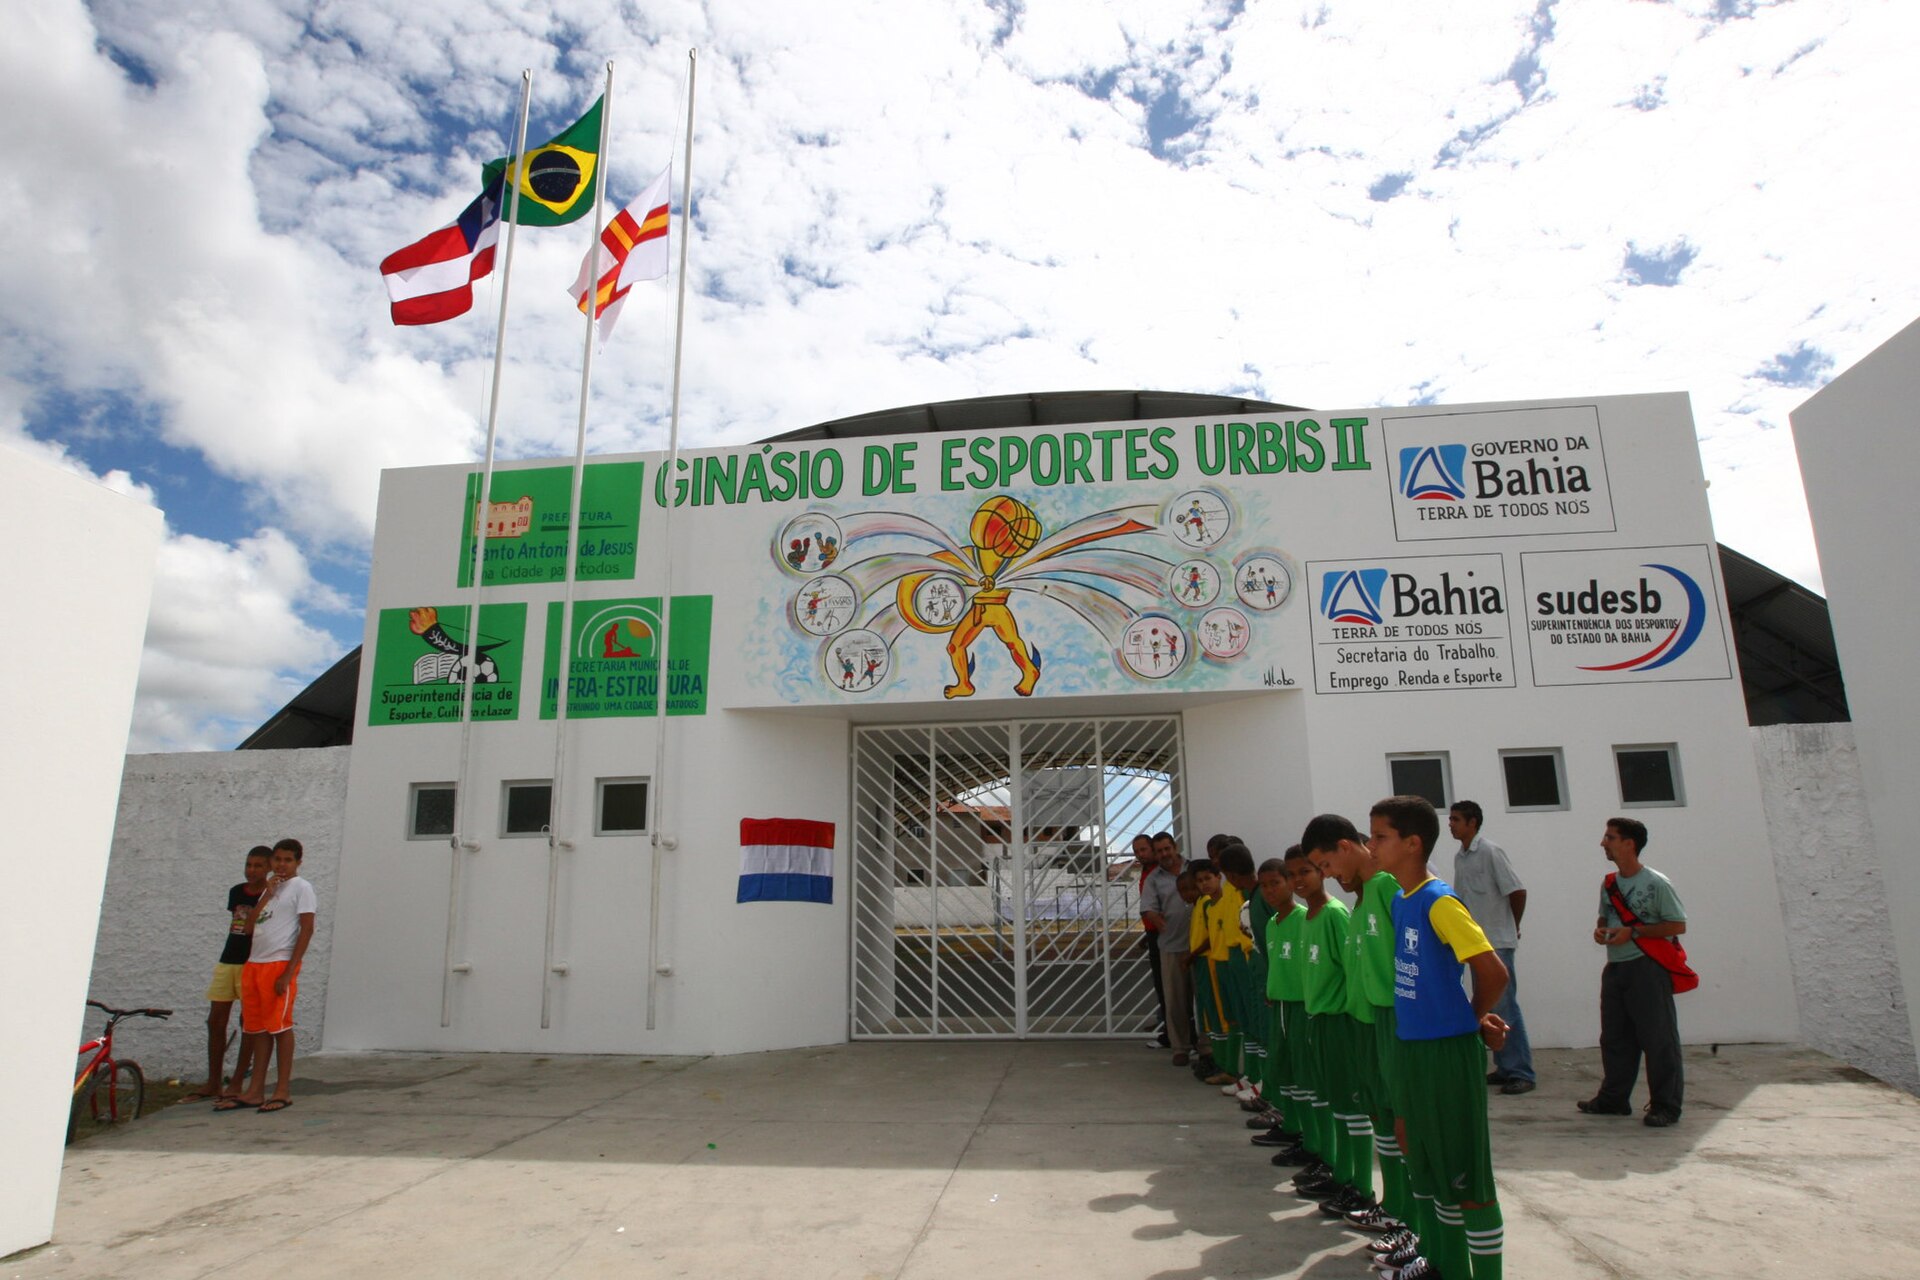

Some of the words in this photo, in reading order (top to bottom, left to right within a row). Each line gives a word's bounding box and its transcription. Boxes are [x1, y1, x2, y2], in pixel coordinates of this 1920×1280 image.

[1471, 438, 1558, 457] GOVERNO
[1565, 436, 1590, 451] DA
[655, 444, 843, 508] GINÁSIO
[862, 442, 918, 496] DE
[940, 427, 1179, 491] ESPORTES
[1195, 419, 1326, 475] URBIS
[1330, 417, 1371, 471] II
[1471, 456, 1592, 499] Bahia
[542, 511, 613, 522] PREFTURA
[1417, 505, 1468, 521] TERRA
[1474, 505, 1494, 518] DE
[1499, 502, 1549, 517] TODOS
[1556, 500, 1590, 515] NÓS
[518, 540, 571, 561] Antoni
[580, 540, 595, 556] de
[596, 538, 634, 557] Jesus
[501, 563, 544, 580] Cidade
[579, 560, 620, 575] todos
[1390, 570, 1505, 618] Bahia
[1537, 578, 1662, 616] sudesb
[1332, 626, 1378, 639] TERRA
[1384, 626, 1399, 637] DE
[1405, 624, 1449, 636] TODOS
[1455, 620, 1483, 635] NÓS
[1615, 618, 1633, 630] DOS
[1635, 618, 1679, 630] DESPORTOS
[1551, 633, 1563, 645] DO
[1567, 632, 1601, 645] ESTADO
[1605, 632, 1618, 644] DA
[1621, 632, 1652, 644] BAHIA
[1336, 646, 1408, 664] Secretaria
[1413, 647, 1429, 662] do
[569, 660, 626, 673] ECRETARIA
[629, 658, 677, 671] MUNICIAL
[679, 659, 690, 671] DE
[547, 674, 703, 699] INFRA-ESTRUURA
[1330, 672, 1389, 690] Emprego
[1398, 669, 1440, 686] Renda
[1443, 674, 1450, 684] e
[1454, 667, 1503, 687] Esporte
[497, 688, 513, 700] de
[487, 705, 513, 717] Lazer
[604, 700, 623, 711] UMA
[624, 700, 653, 710] CIDADE
